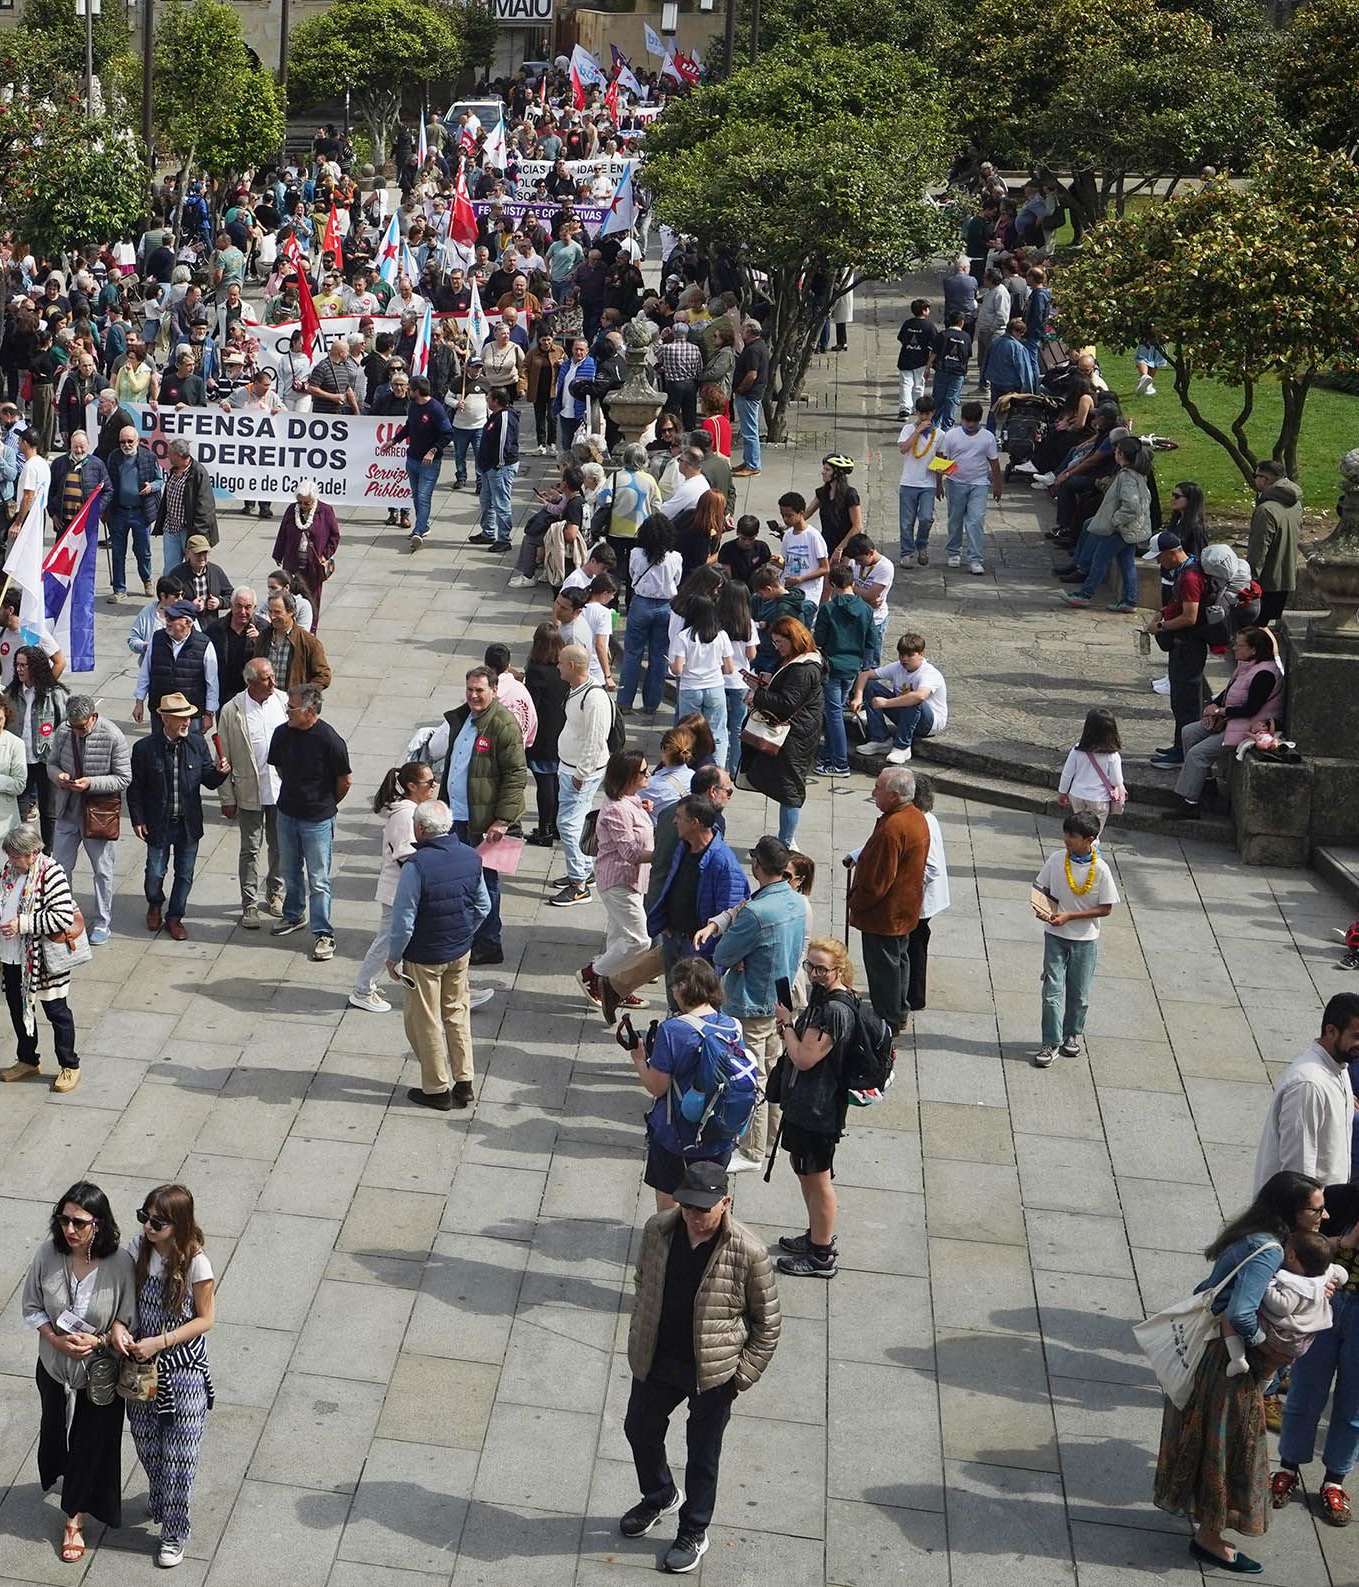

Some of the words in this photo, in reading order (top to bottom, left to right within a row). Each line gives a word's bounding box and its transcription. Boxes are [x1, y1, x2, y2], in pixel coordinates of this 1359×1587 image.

[141, 411, 276, 438] DEFENSA
[288, 418, 349, 441] DOS
[198, 442, 347, 470] DEREITOS
[209, 472, 244, 493] alego
[249, 478, 257, 490] e
[261, 474, 278, 491] de
